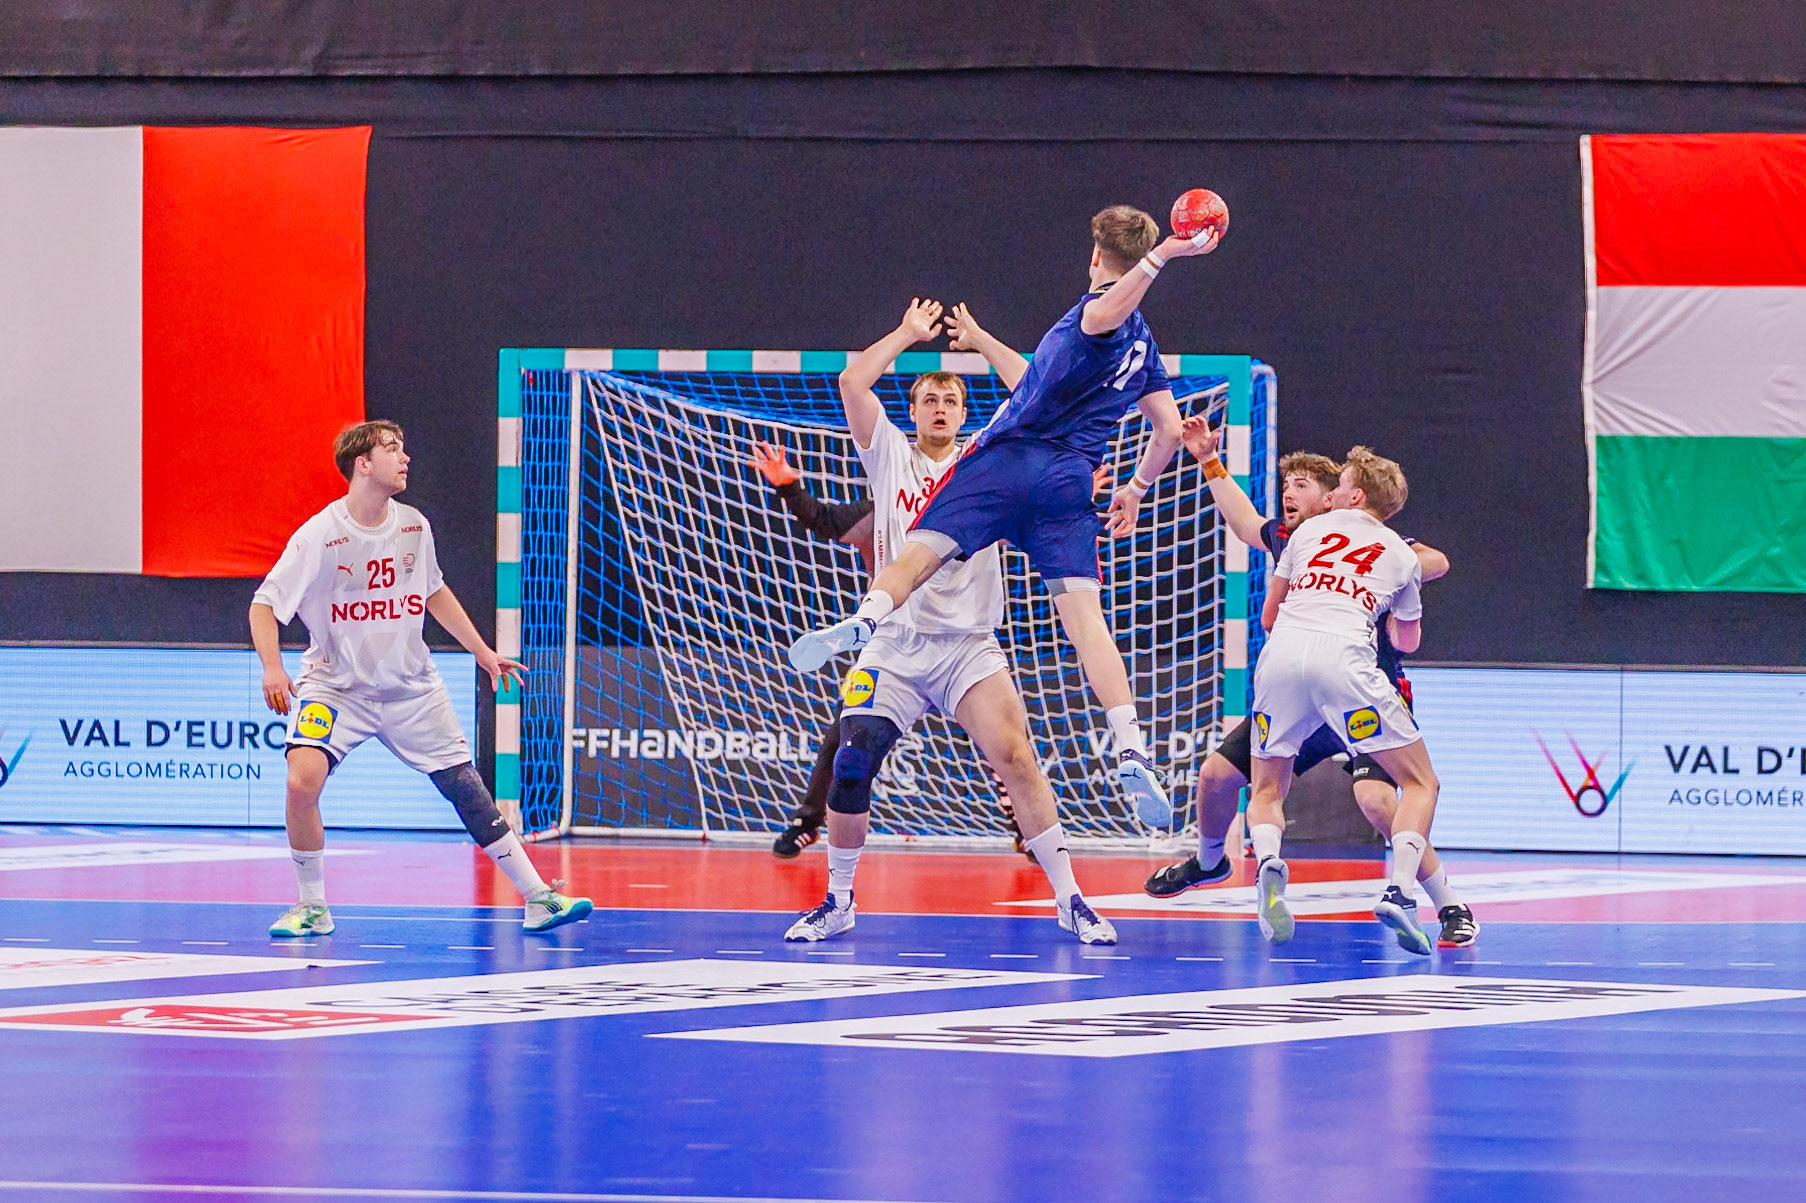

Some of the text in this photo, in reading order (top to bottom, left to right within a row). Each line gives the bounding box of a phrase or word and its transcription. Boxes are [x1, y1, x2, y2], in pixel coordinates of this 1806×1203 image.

[325, 536, 349, 548] NORLYS
[401, 525, 423, 534] NORLYS
[1307, 533, 1386, 577] 24
[366, 557, 396, 590] 25
[331, 594, 424, 623] NORLYS
[59, 718, 131, 747] VAL
[64, 759, 261, 780] AGGLOMÉRATION
[1664, 745, 1740, 774] VAL
[840, 984, 1685, 1046] ACADOMIA
